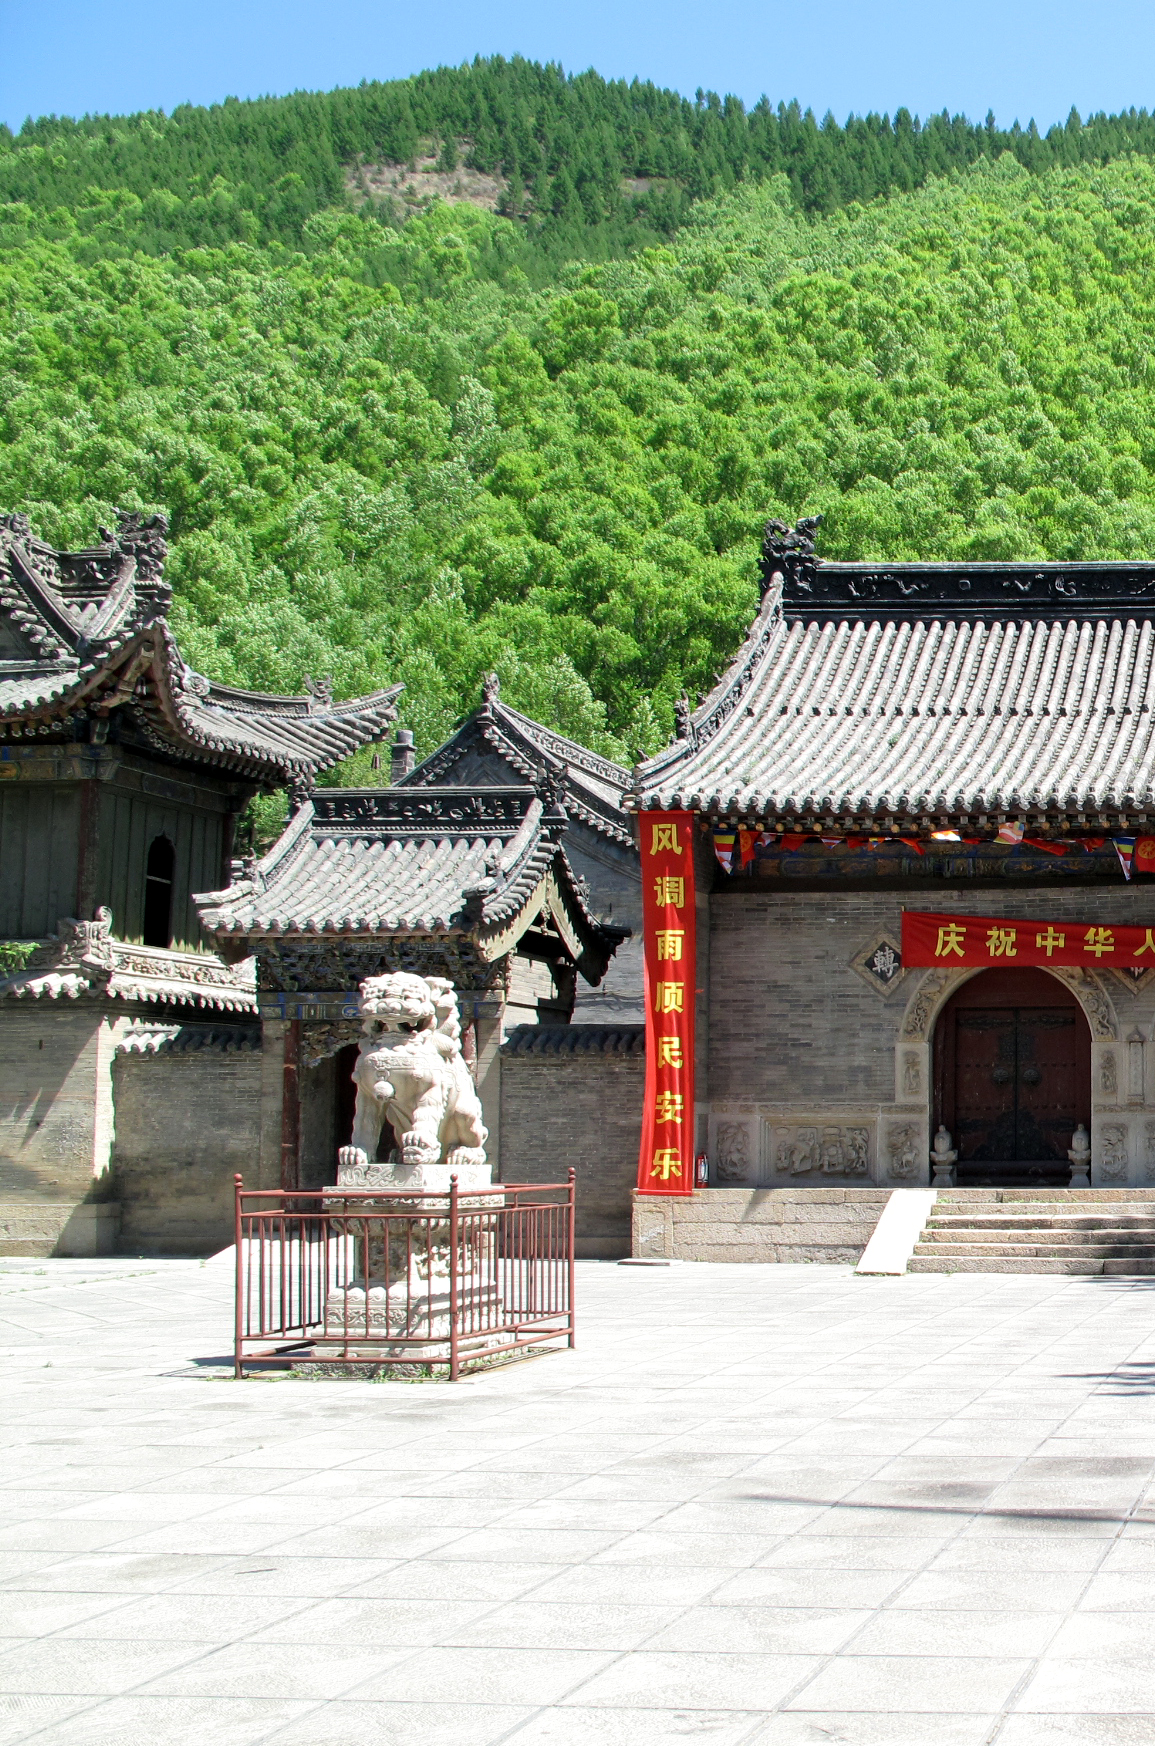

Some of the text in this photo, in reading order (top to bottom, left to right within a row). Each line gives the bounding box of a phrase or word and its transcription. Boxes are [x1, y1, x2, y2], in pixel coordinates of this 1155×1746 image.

[650, 823, 684, 1180] 风调雨顺民安乐
[872, 946, 899, 978] 轉
